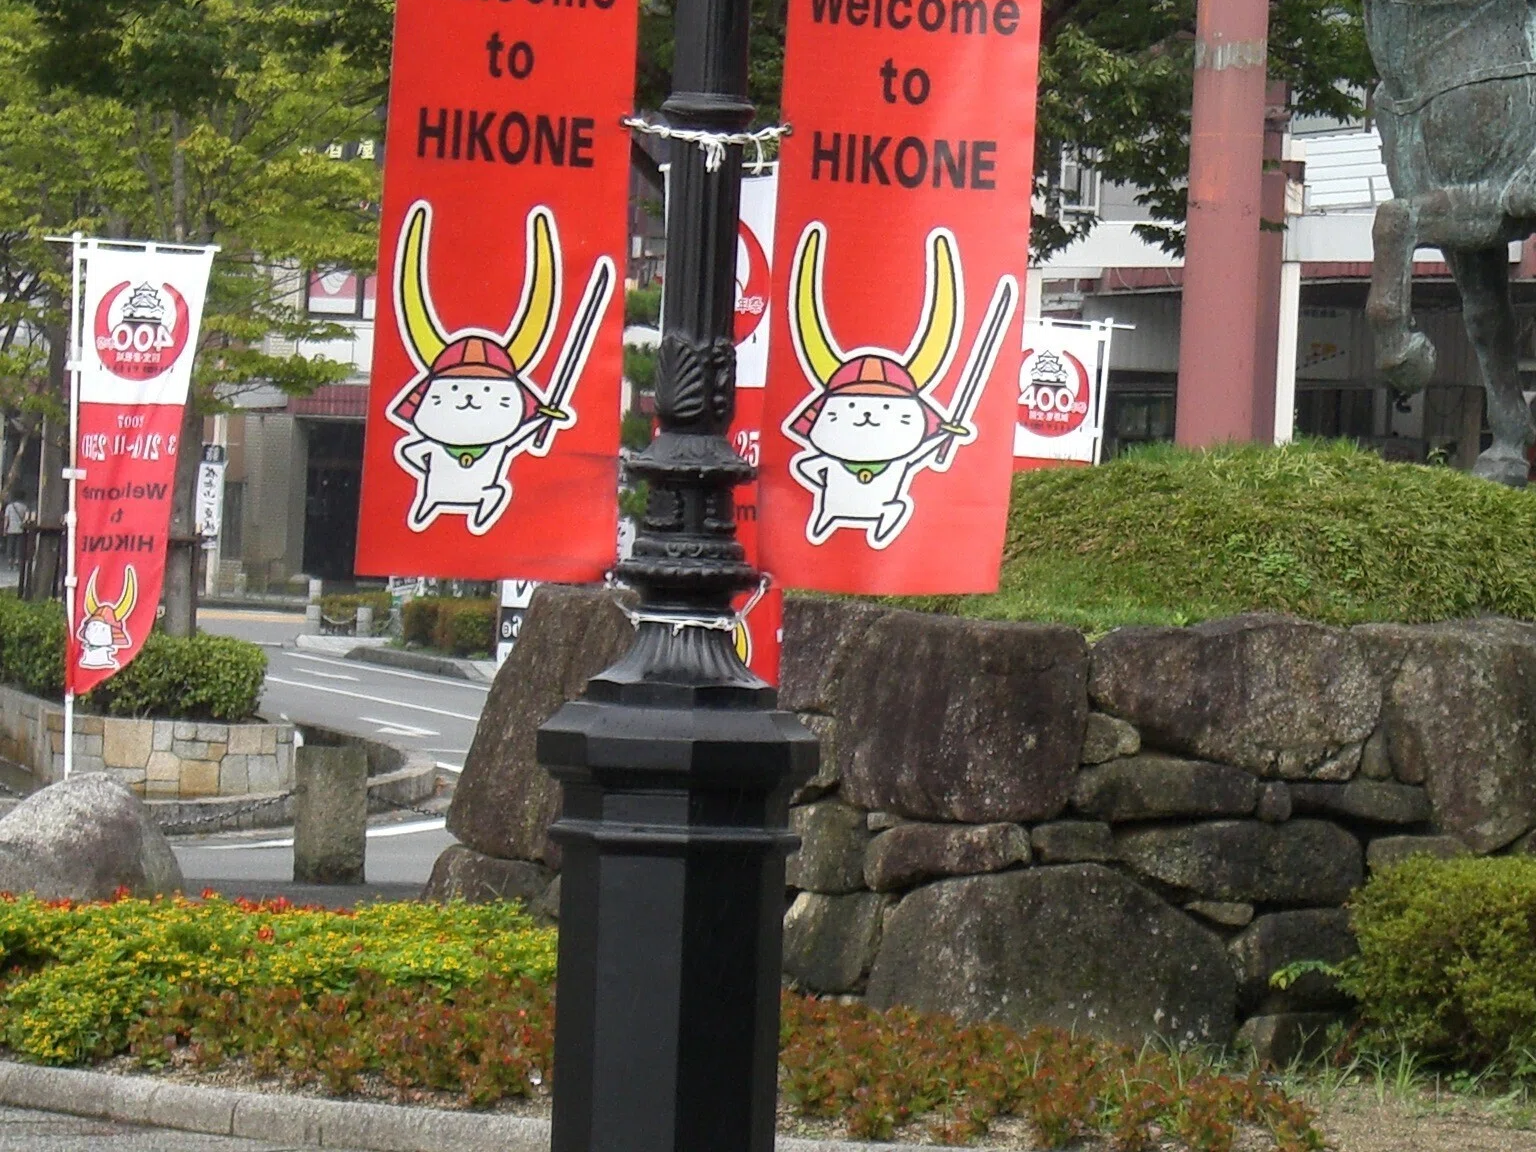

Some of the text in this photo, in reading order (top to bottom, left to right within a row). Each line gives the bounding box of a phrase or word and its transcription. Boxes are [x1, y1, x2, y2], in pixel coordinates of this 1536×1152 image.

[486, 32, 535, 79] to
[879, 58, 931, 106] to
[417, 107, 595, 169] HIKONE
[811, 130, 997, 192] HIKONE
